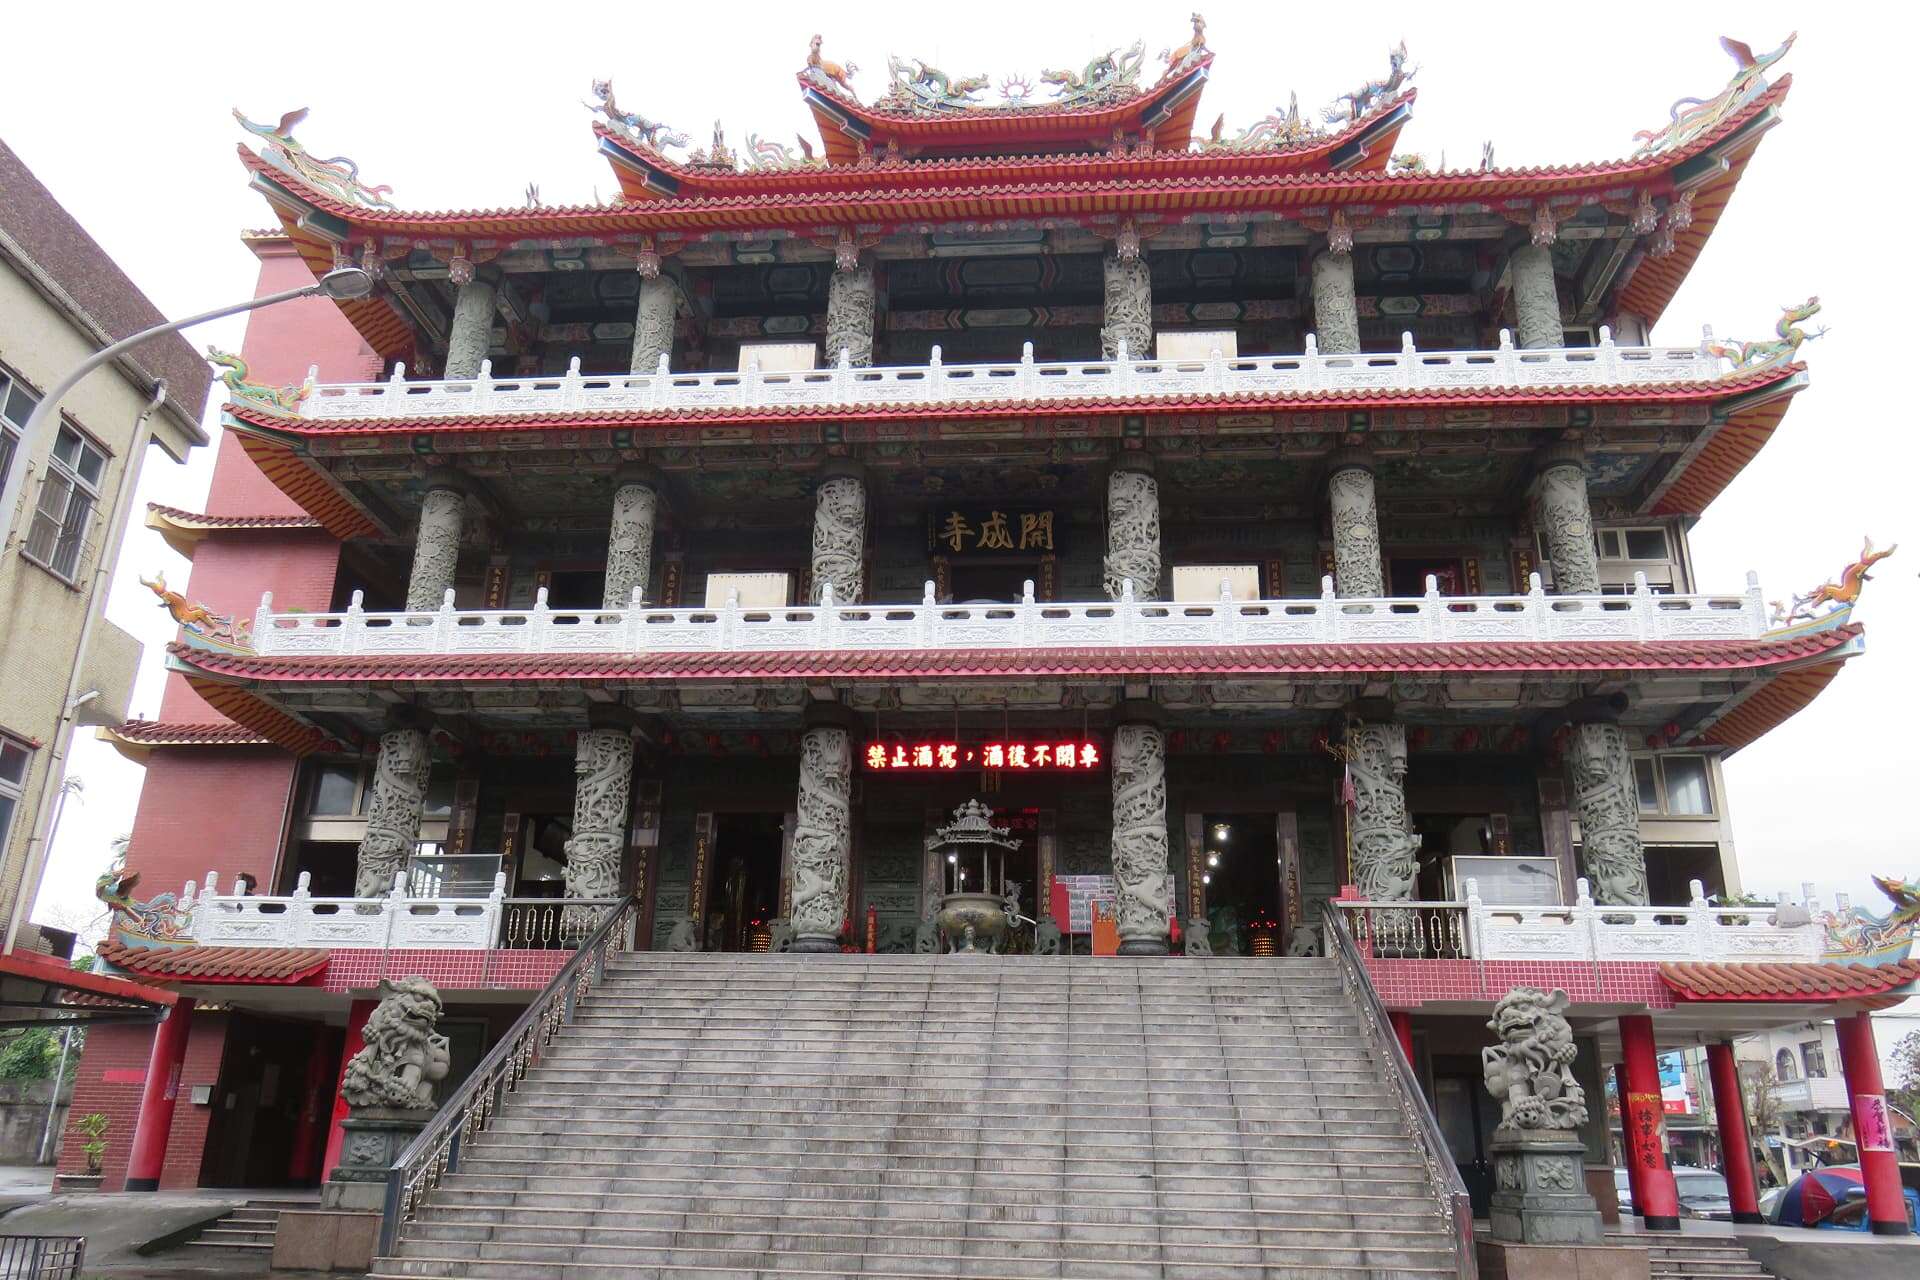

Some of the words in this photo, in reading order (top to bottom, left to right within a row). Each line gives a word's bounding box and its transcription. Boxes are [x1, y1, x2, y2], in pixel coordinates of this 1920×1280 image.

[867, 744, 1099, 768] 禁止酒駕，酒後不開車
